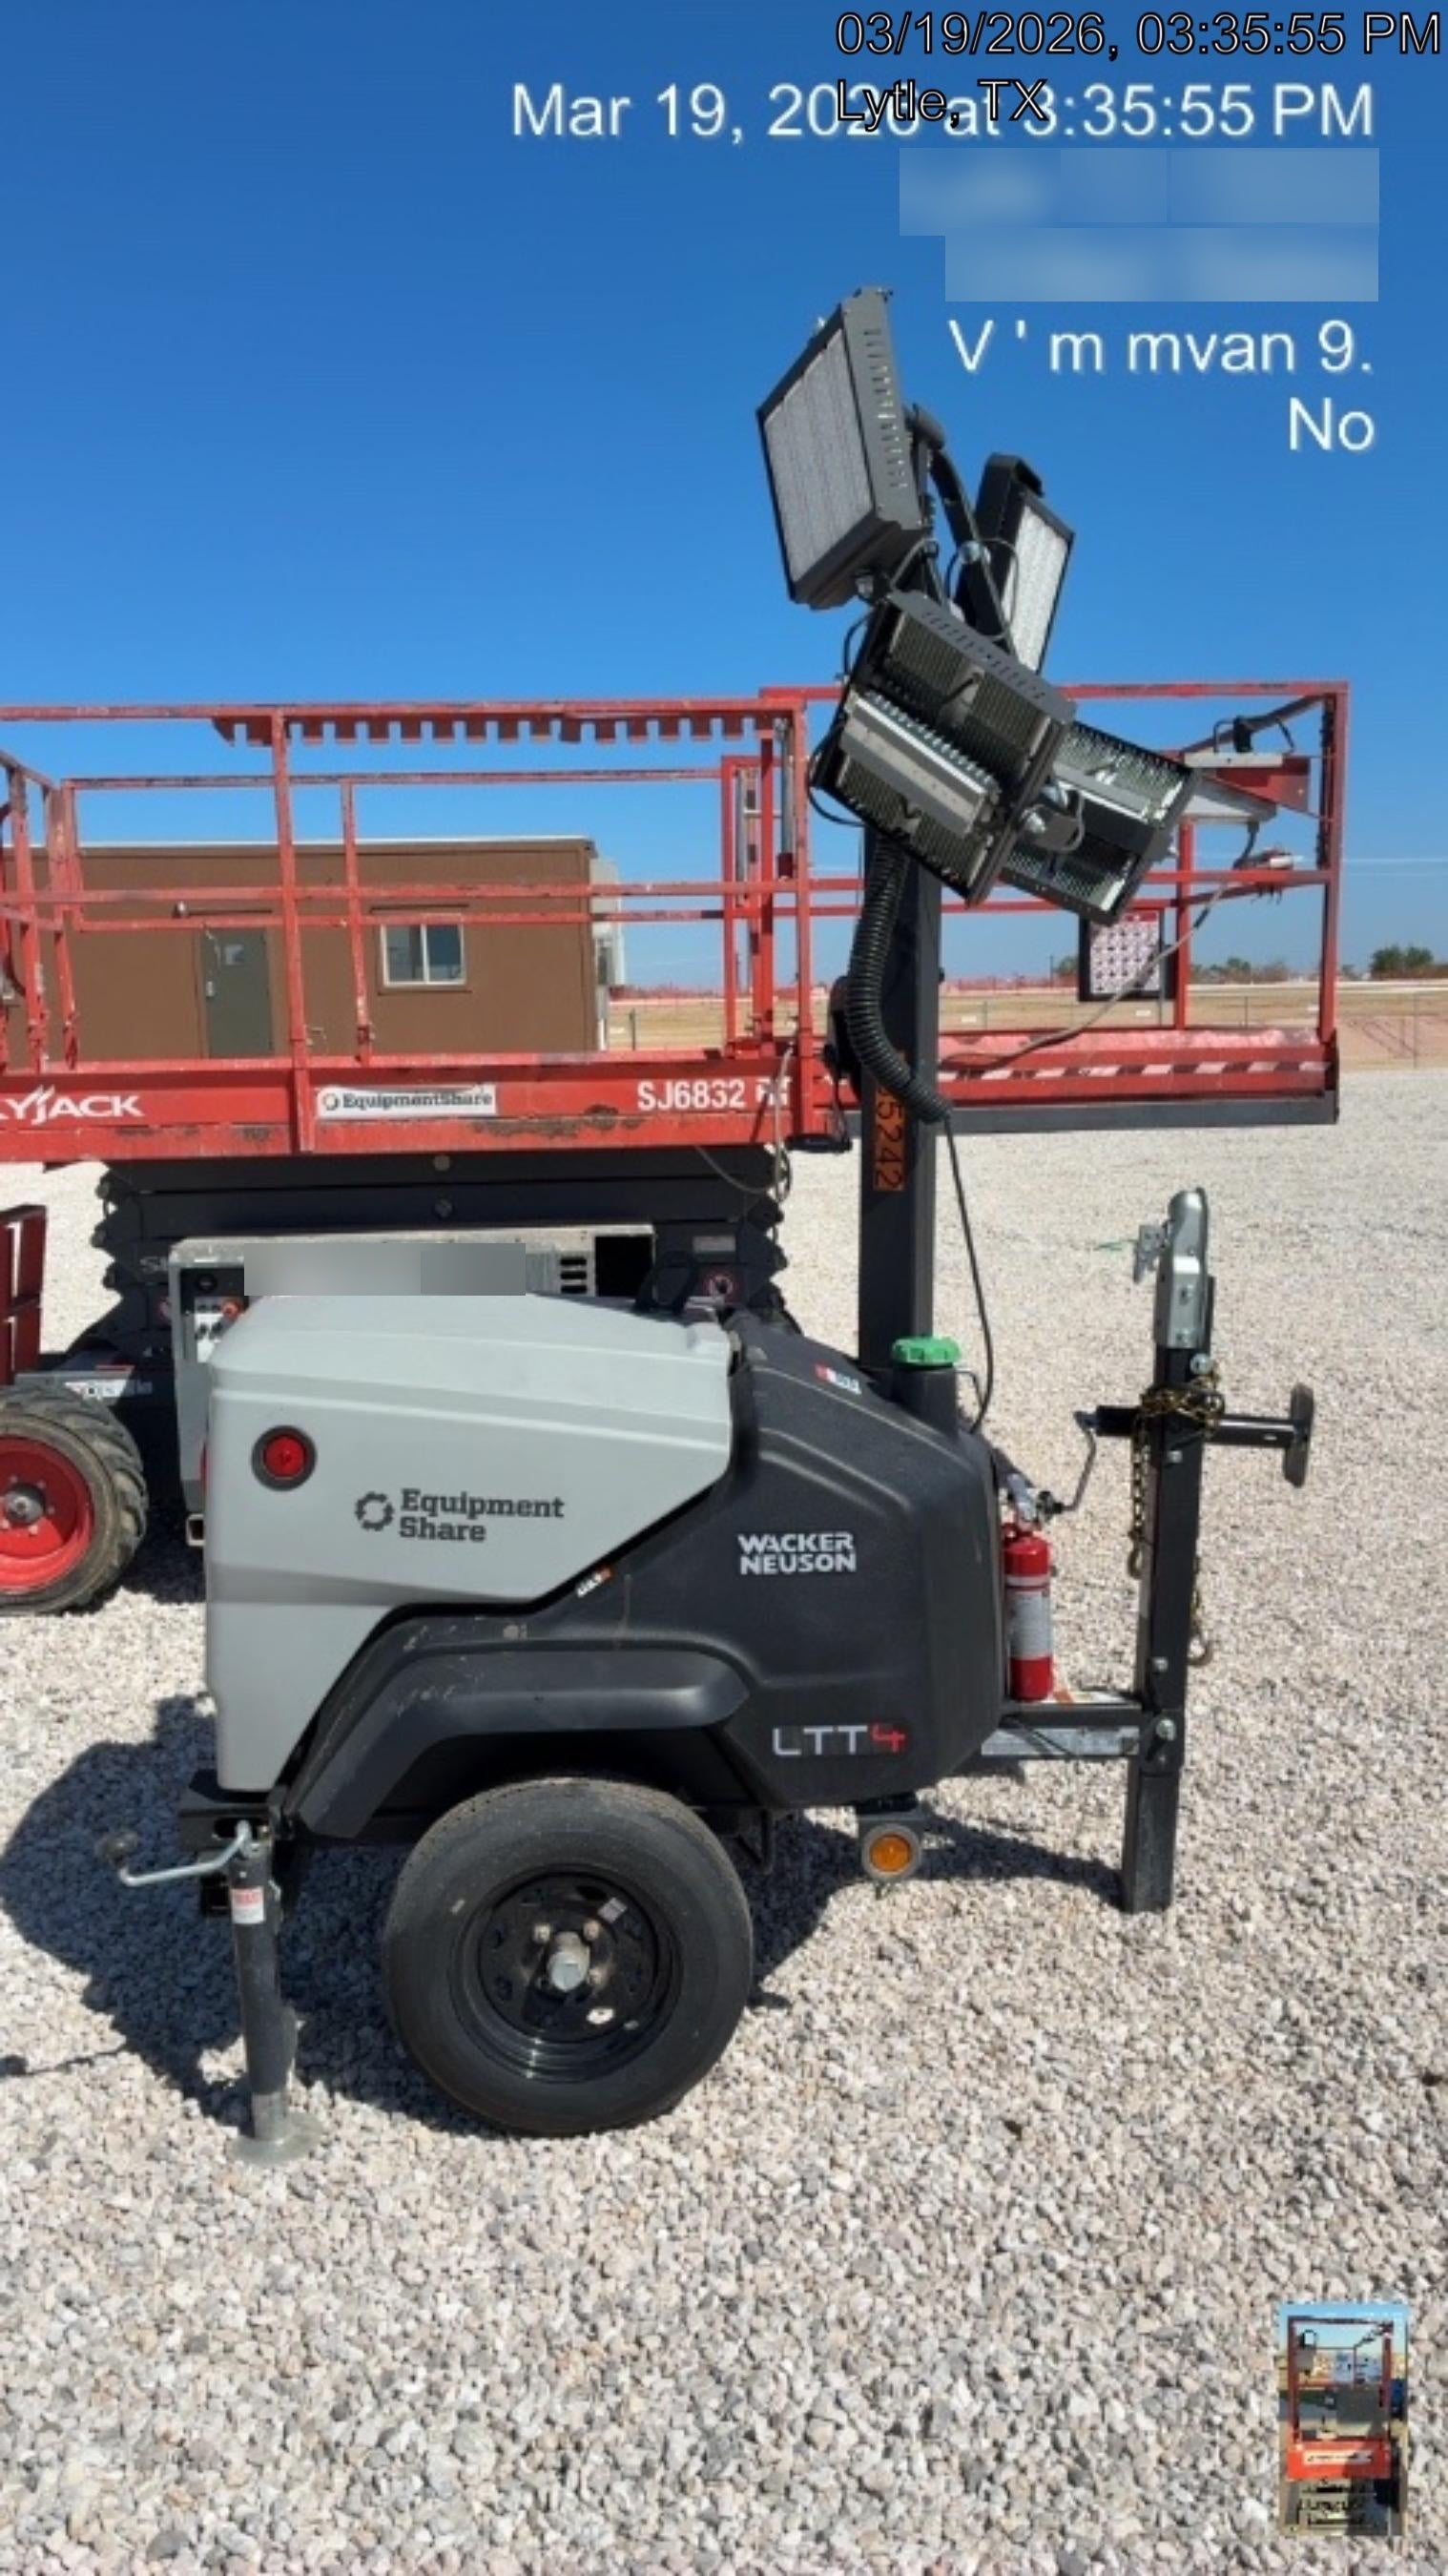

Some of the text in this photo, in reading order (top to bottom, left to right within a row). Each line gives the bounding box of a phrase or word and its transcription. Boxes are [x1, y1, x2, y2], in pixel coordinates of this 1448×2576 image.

[0, 1084, 145, 1126] YJACK
[636, 1079, 748, 1111] SJ6832
[401, 1487, 566, 1520] Equipment
[398, 1515, 487, 1543] Share
[736, 1530, 855, 1555] WACKER
[740, 1552, 858, 1575] NEUSON
[771, 1720, 907, 1757] LTT4
